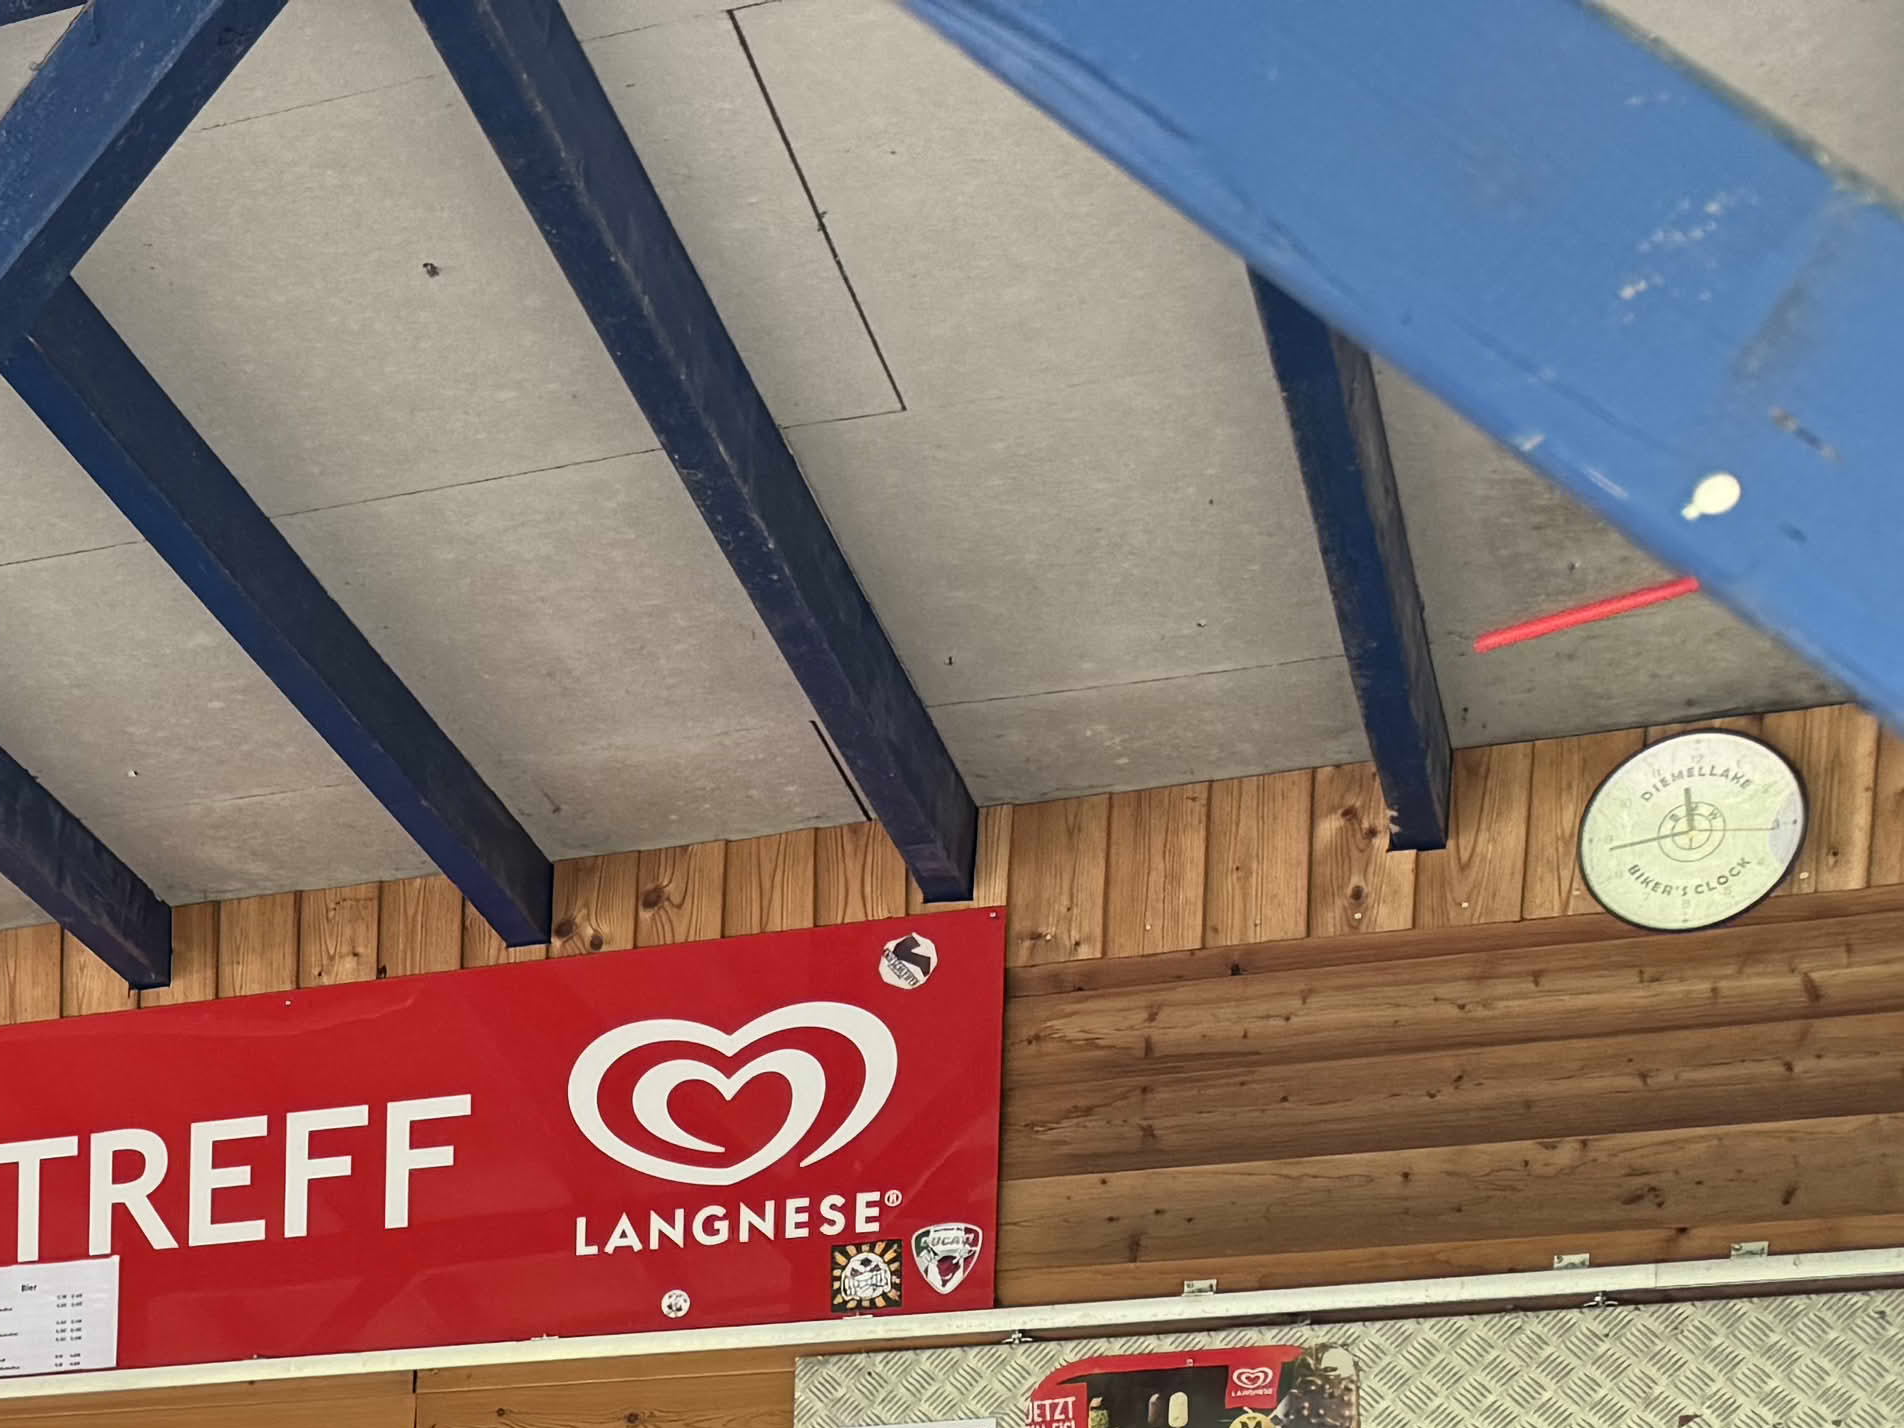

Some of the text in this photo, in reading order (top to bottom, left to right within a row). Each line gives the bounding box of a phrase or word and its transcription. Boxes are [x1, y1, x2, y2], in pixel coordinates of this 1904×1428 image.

[1641, 765, 1754, 803] DIEMELLAKE
[1694, 856, 1752, 896] CLOCK
[576, 1190, 882, 1257] LANGNESE
[1024, 1396, 1076, 1424] JETZT
